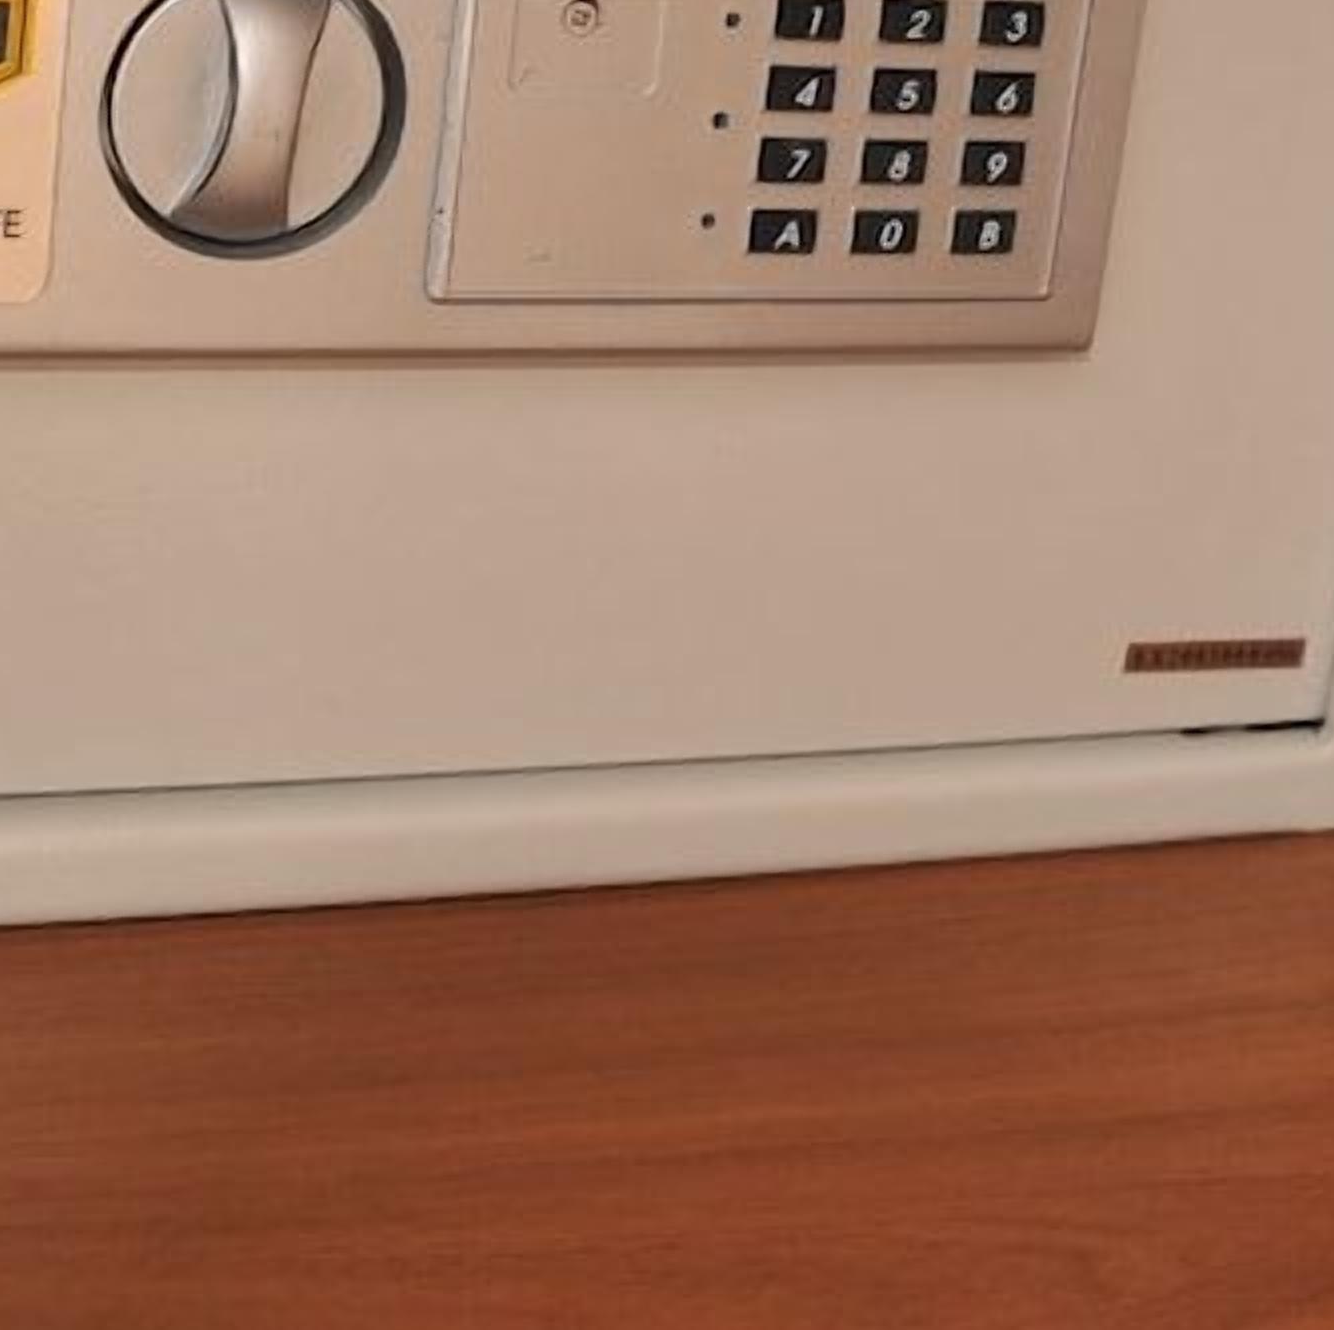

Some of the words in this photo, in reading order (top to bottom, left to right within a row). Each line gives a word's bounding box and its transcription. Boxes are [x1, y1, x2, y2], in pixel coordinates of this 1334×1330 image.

[808, 5, 824, 36] 1
[905, 9, 931, 39] 2
[1005, 11, 1028, 43] 3
[795, 76, 819, 107] 4
[896, 79, 919, 111] 5
[995, 82, 1018, 113] 6
[786, 149, 811, 180] 7
[887, 149, 911, 181] 8
[986, 151, 1008, 183] 9
[774, 221, 800, 251] A
[978, 220, 1000, 251] B
